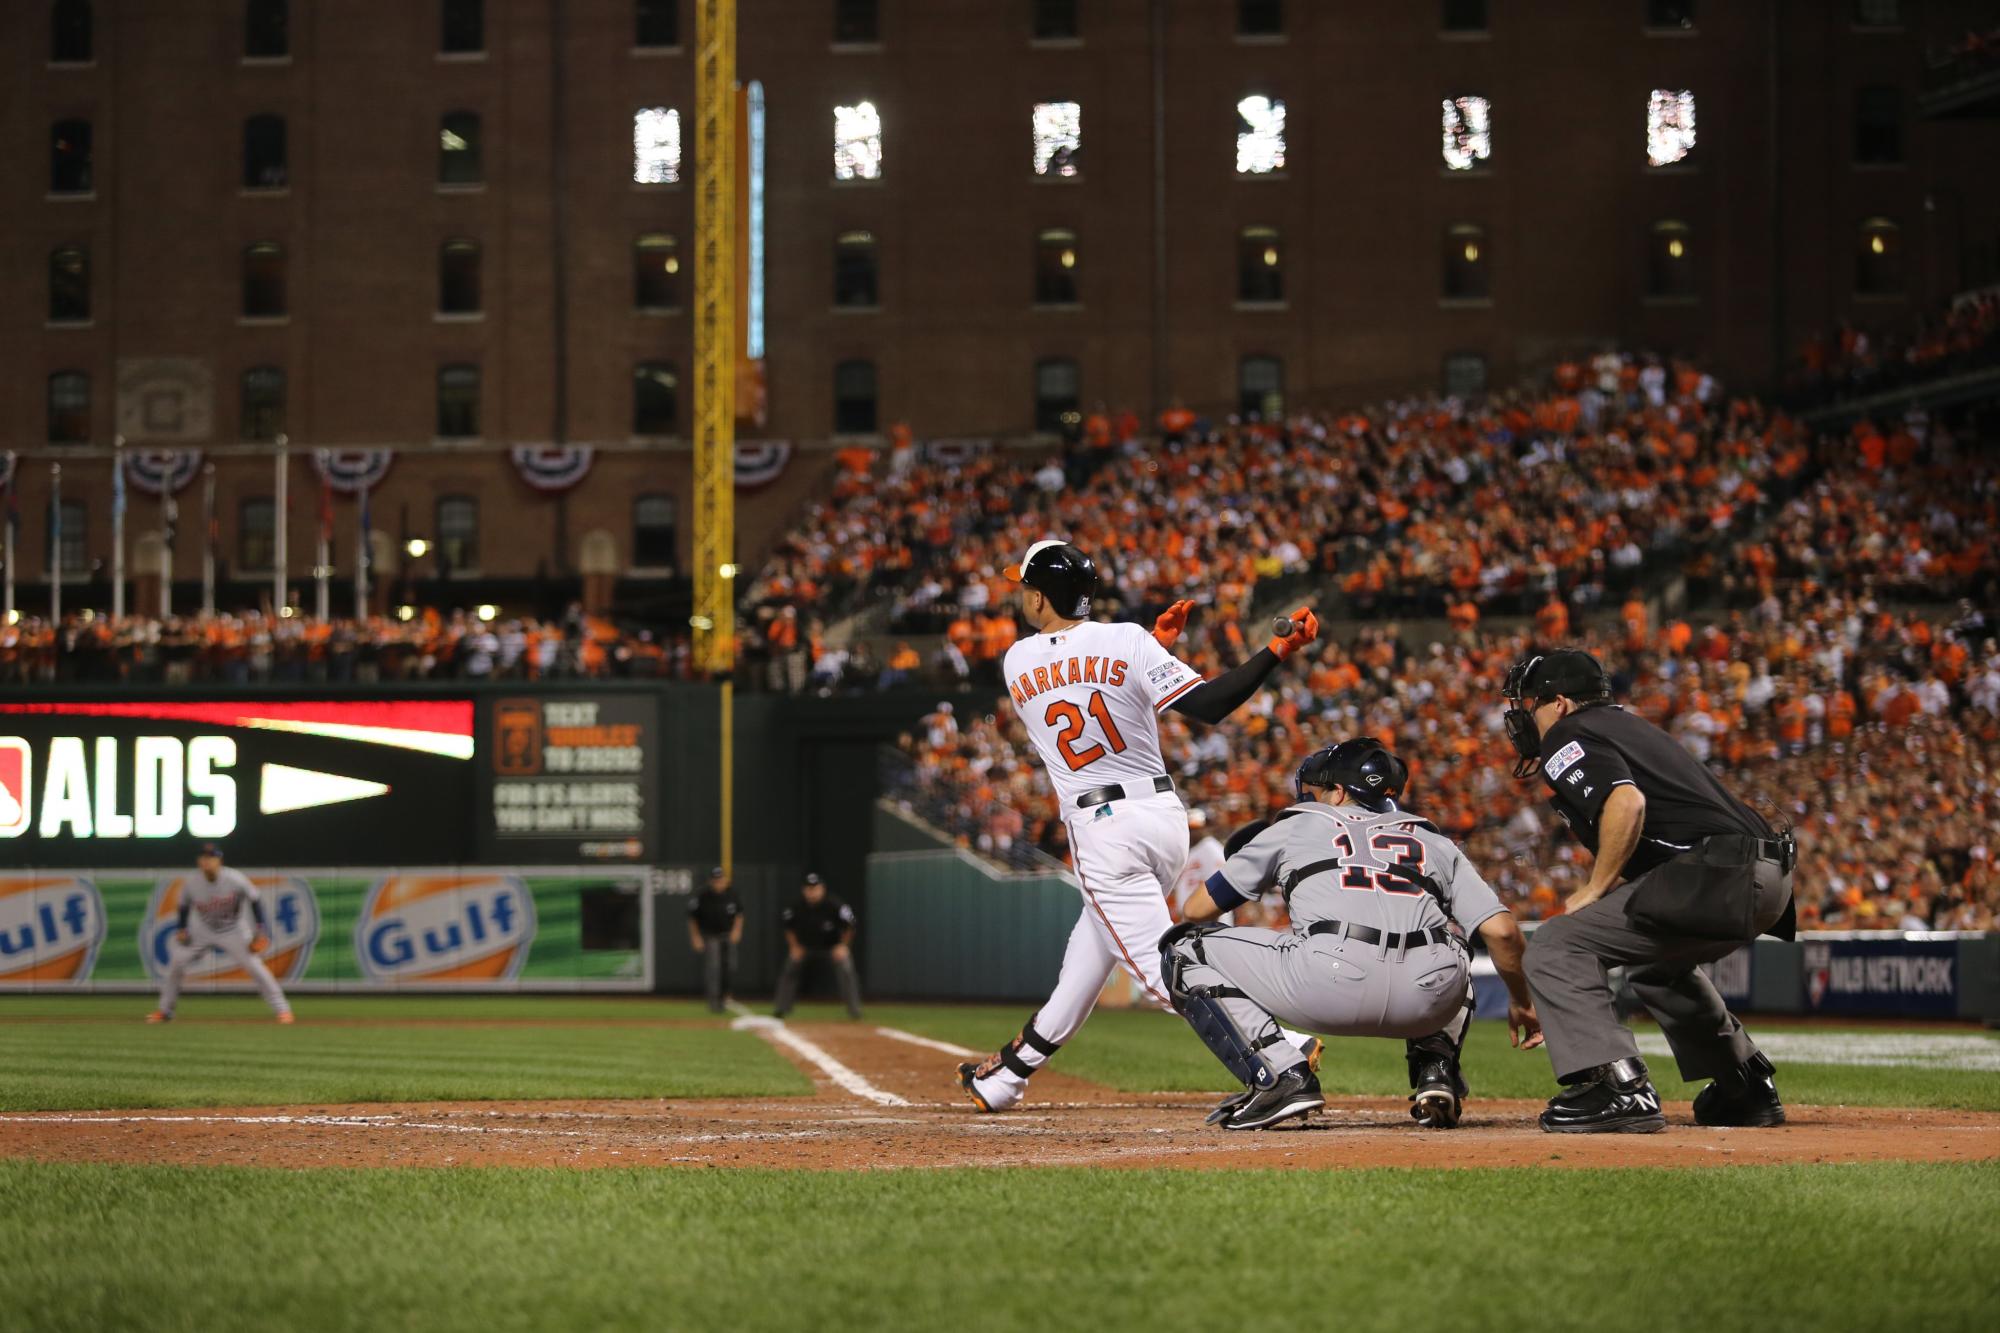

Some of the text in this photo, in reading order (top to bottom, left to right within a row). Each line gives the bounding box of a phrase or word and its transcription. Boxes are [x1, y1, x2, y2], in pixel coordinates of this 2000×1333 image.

[1010, 656, 1128, 709] MARKAKIS
[1045, 690, 1127, 772] 21
[40, 735, 237, 839] ALDS
[1566, 769, 1585, 785] WB
[1332, 833, 1426, 898] 13
[0, 894, 86, 955] ulf
[368, 893, 516, 967] Gulf
[1832, 957, 1954, 995] MLB NETWORK
